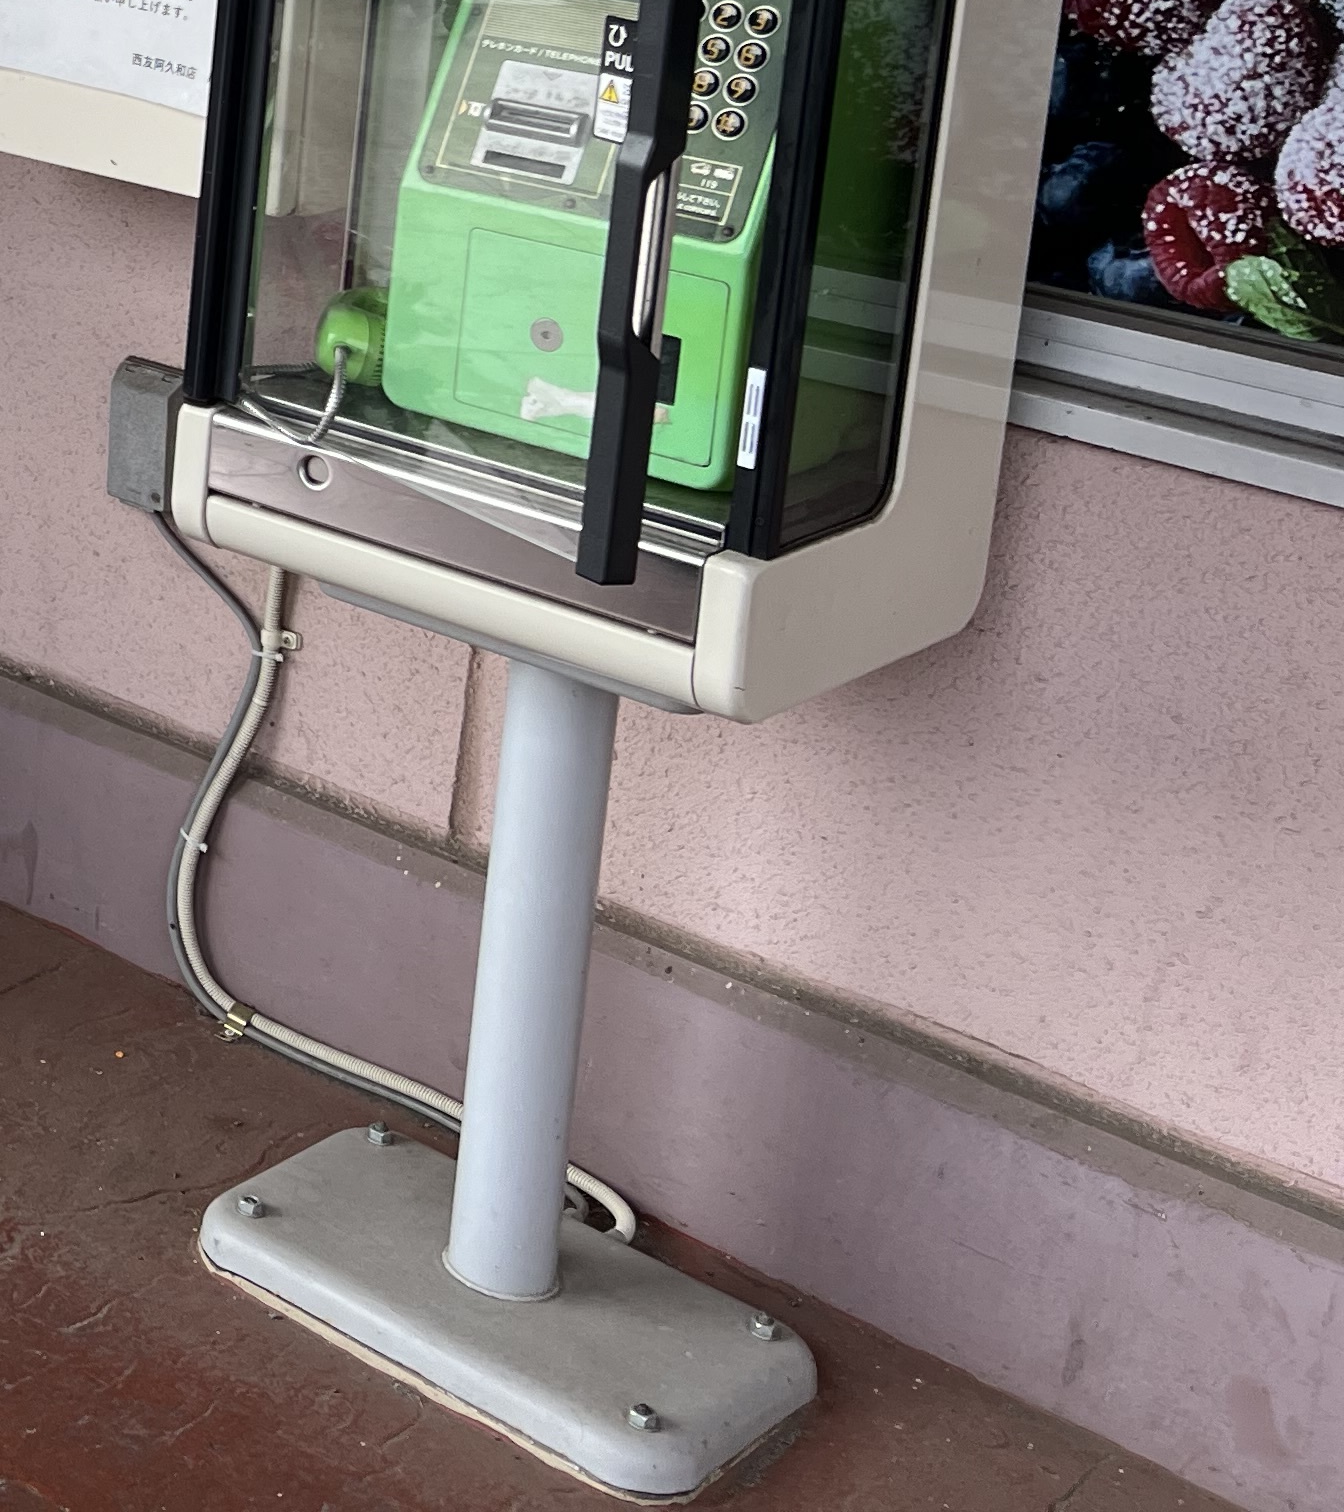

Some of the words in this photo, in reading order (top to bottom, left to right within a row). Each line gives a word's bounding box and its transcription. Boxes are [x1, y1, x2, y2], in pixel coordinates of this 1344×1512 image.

[715, 4, 736, 27] 2
[751, 11, 770, 32] 3
[608, 24, 628, 47] ひ
[604, 50, 634, 73] PUL
[706, 38, 724, 60] 5
[741, 44, 761, 66] 6
[132, 52, 198, 80] 西友阿久和店
[730, 78, 750, 99] 9
